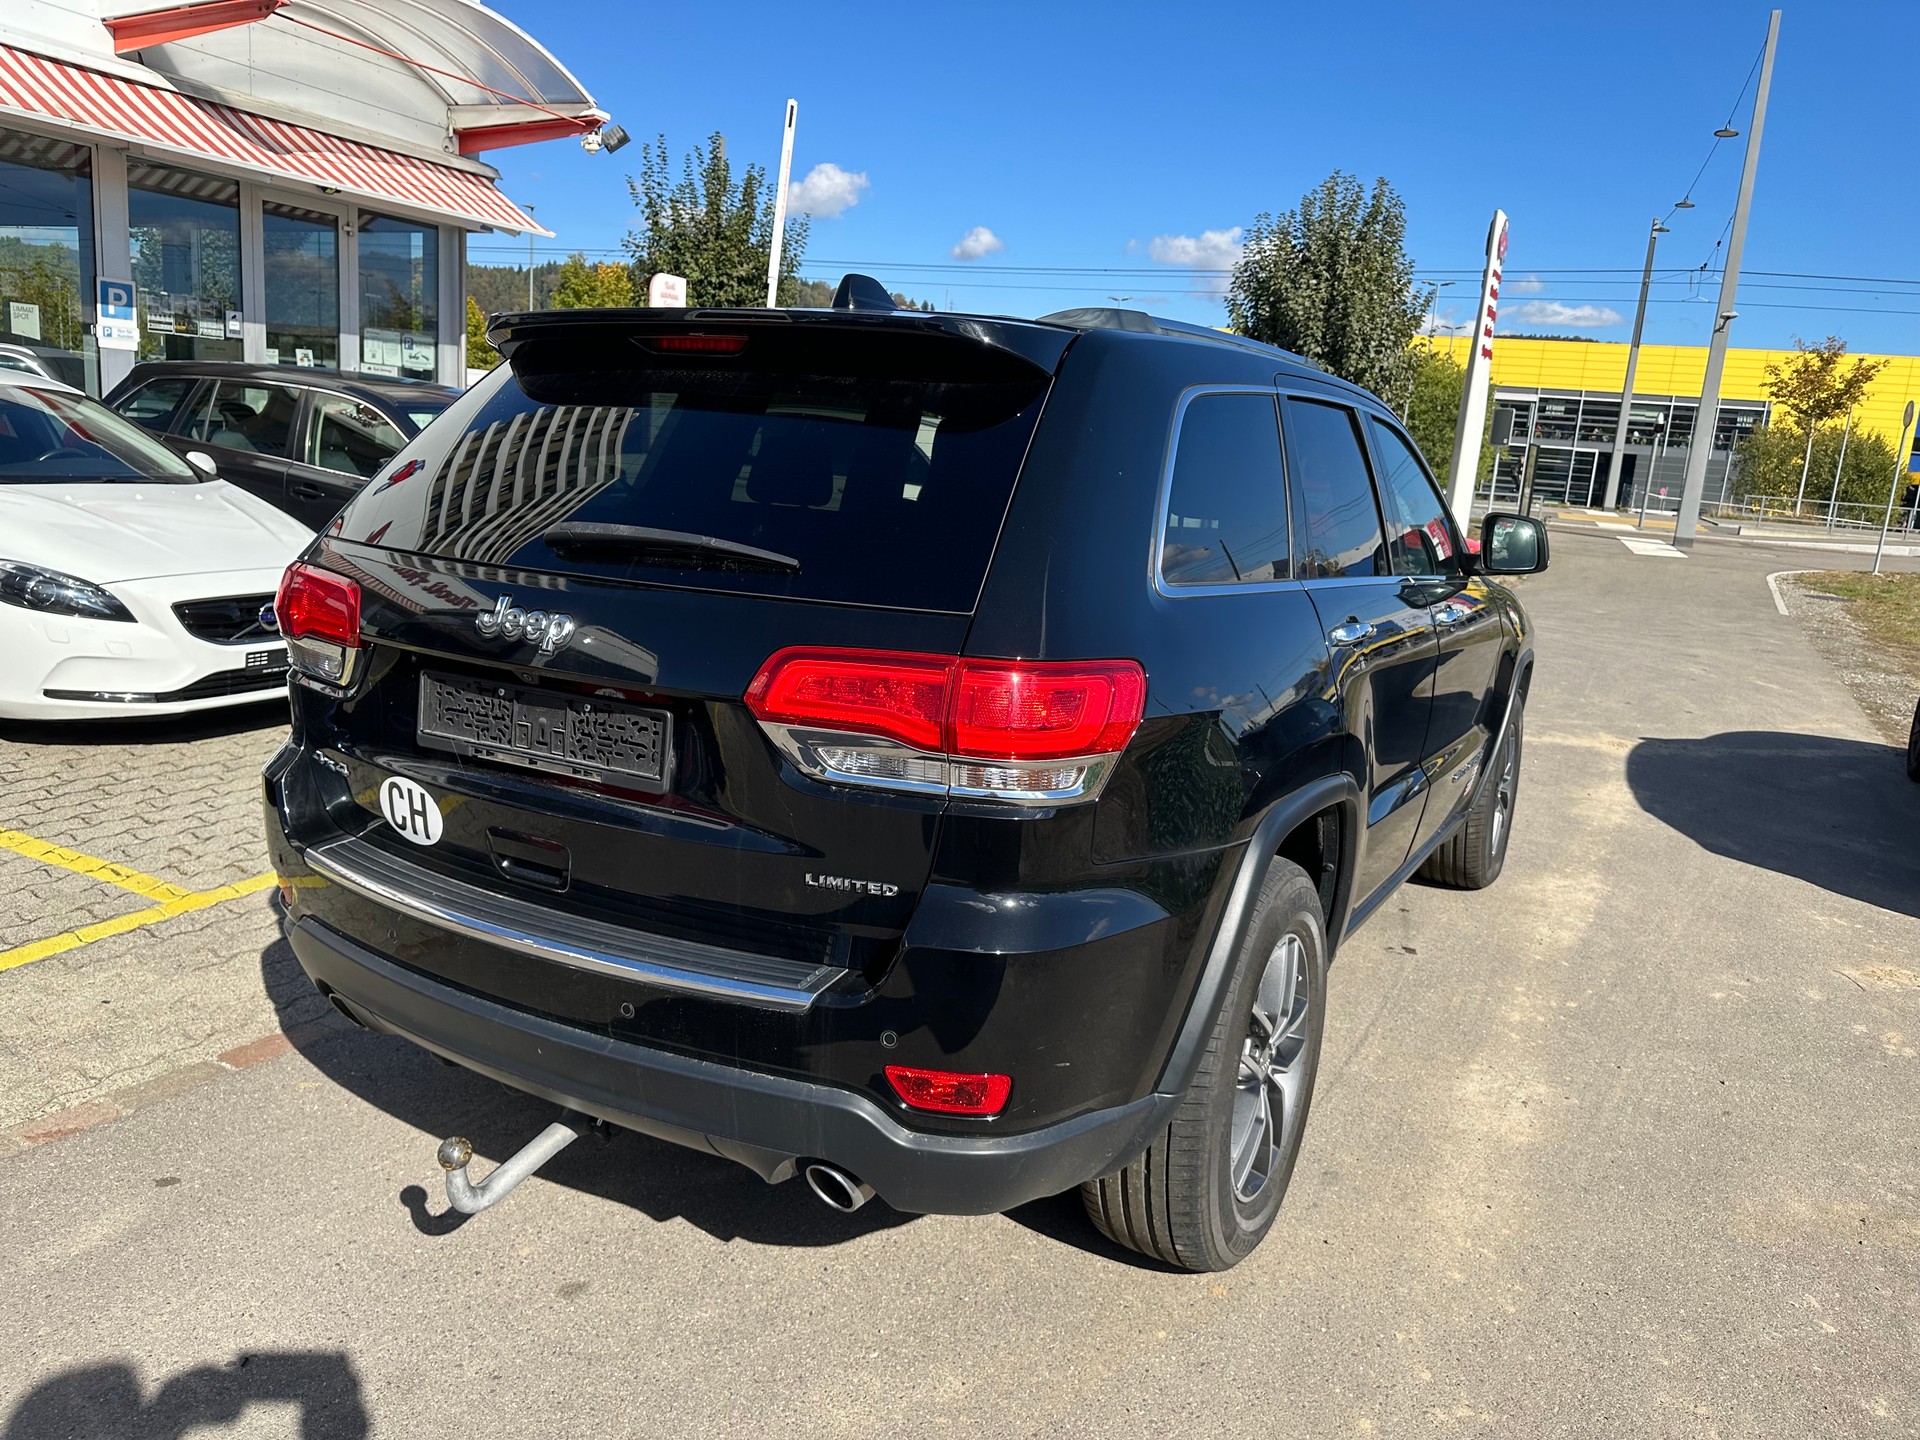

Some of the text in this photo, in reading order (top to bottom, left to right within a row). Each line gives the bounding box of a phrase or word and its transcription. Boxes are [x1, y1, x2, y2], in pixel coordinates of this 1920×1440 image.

[12, 305, 34, 313] LIMMAT
[108, 287, 128, 315] P
[13, 312, 30, 320] SPOT
[475, 592, 576, 656] Jeep
[387, 780, 431, 841] CH
[804, 872, 900, 897] LIMITED
